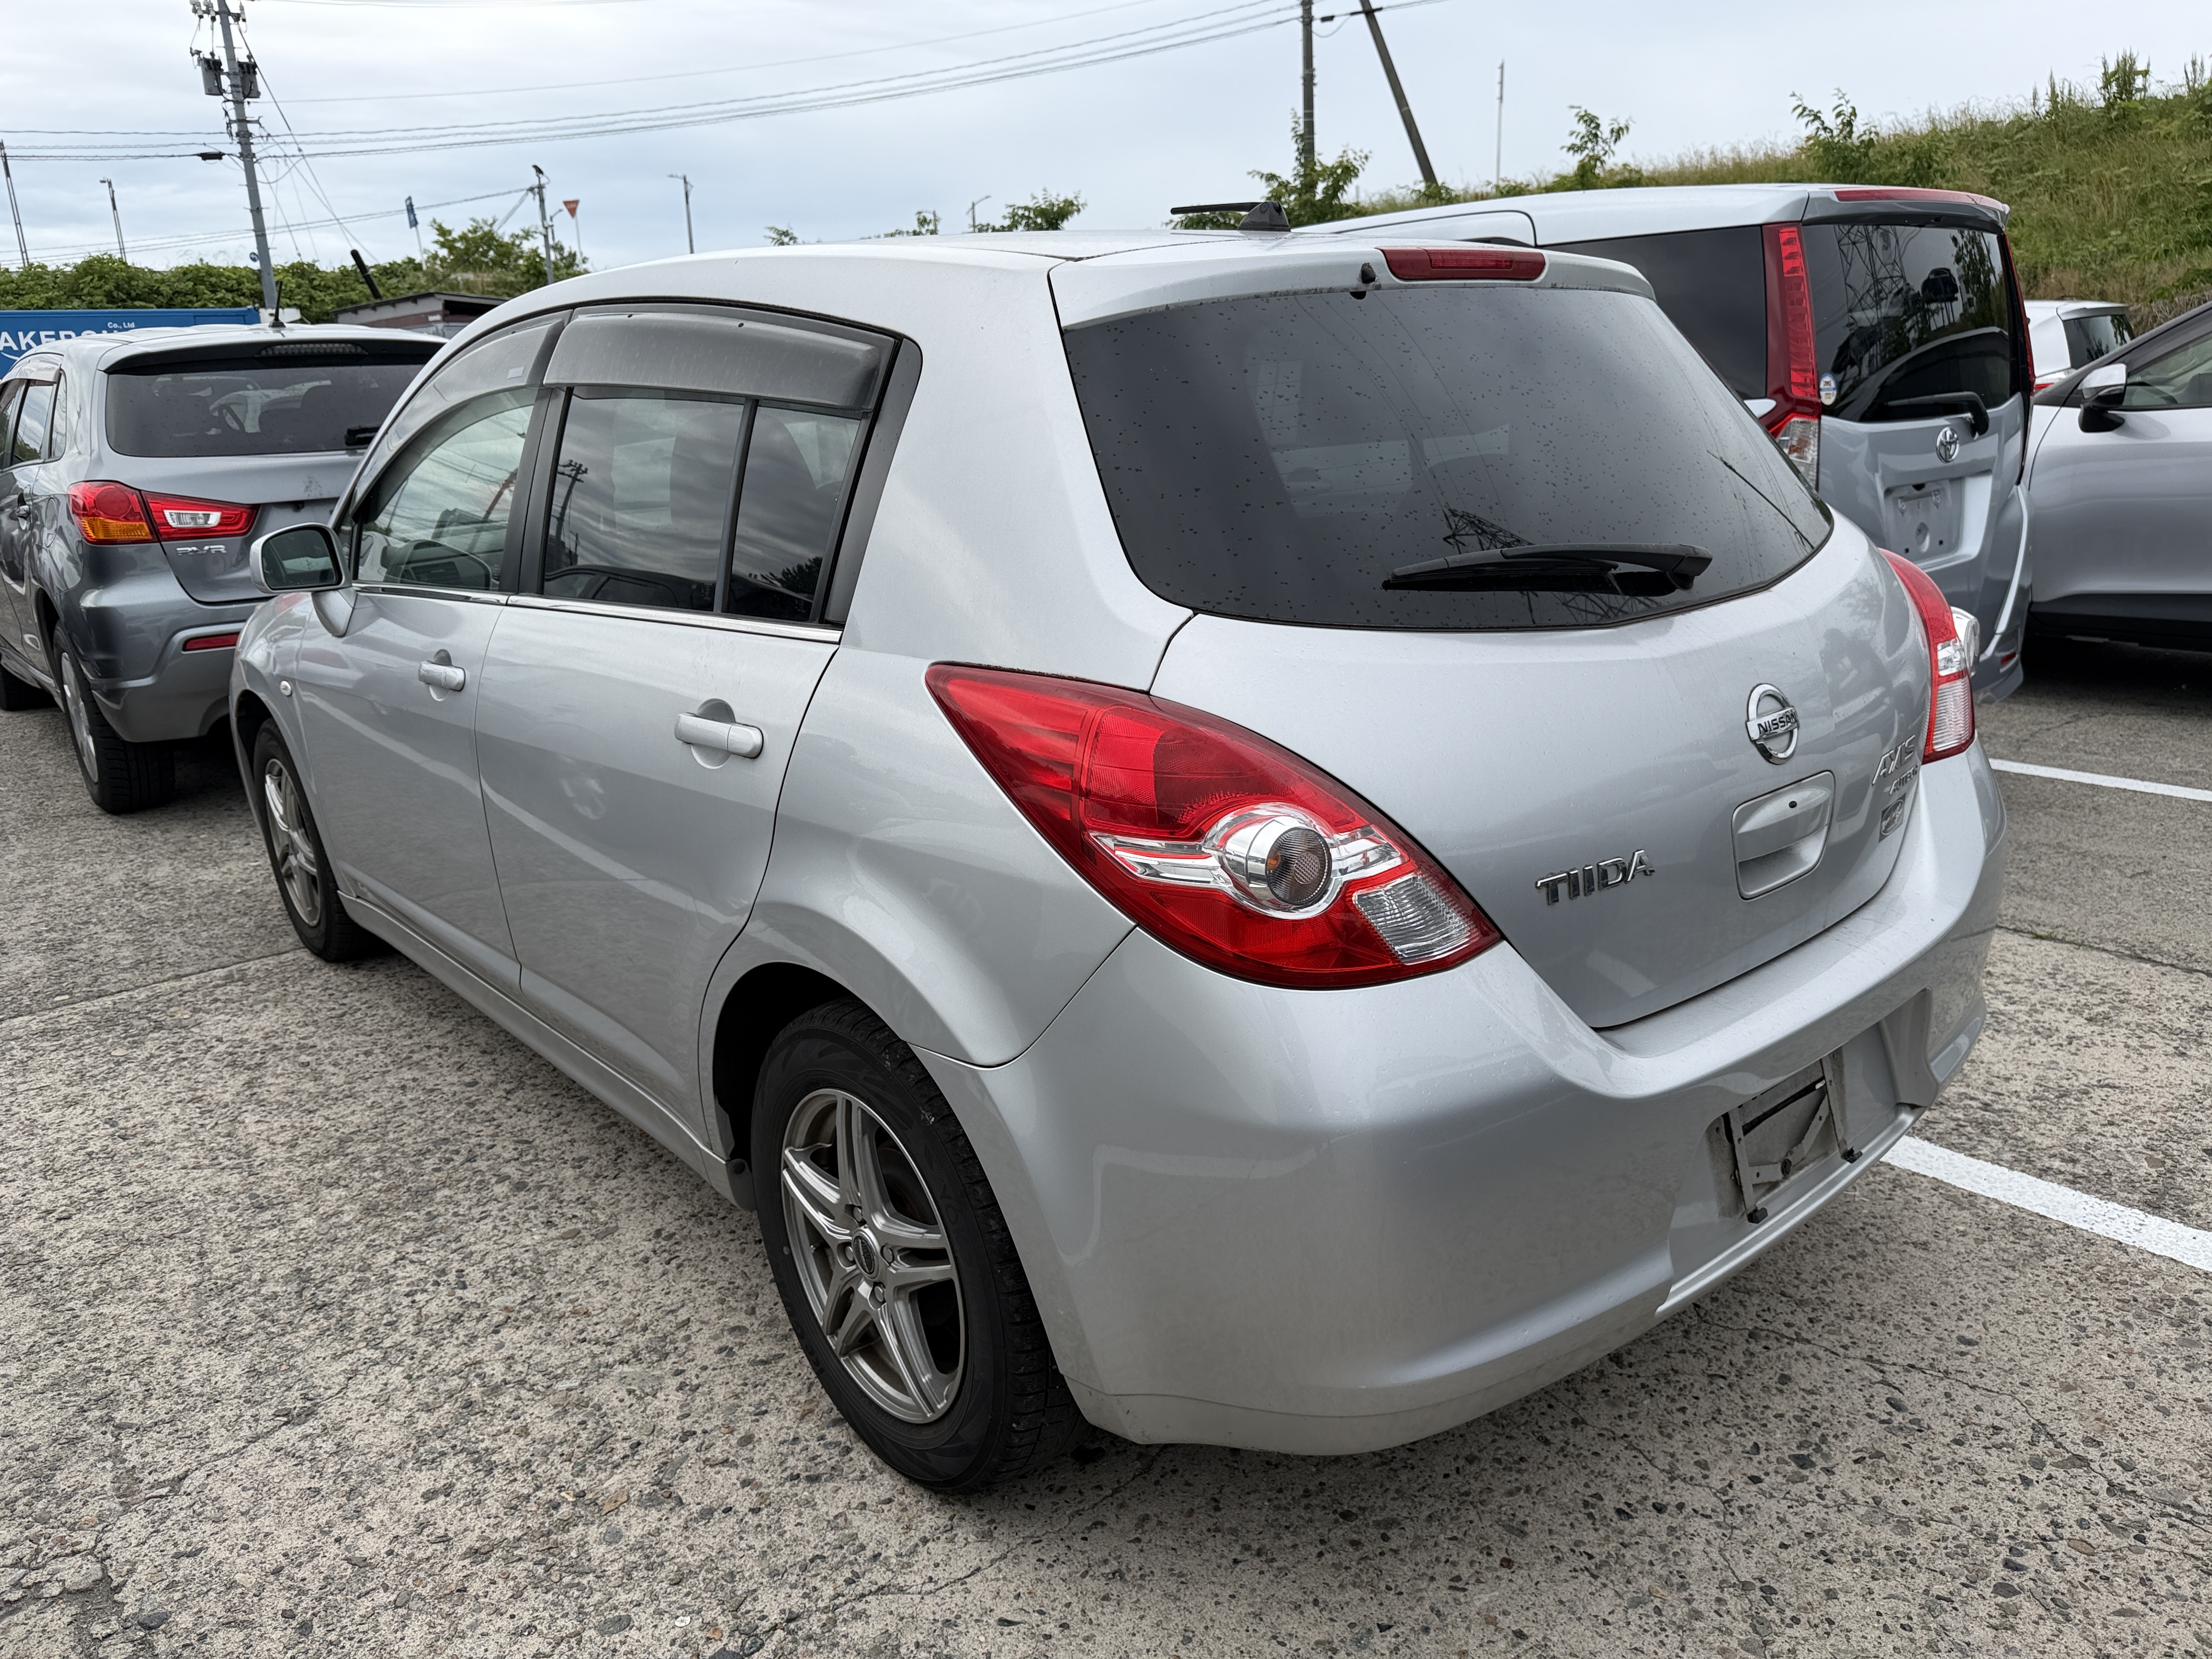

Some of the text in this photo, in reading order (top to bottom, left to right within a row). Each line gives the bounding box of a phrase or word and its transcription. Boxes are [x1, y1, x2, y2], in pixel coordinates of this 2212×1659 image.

[176, 545, 227, 557] RVR
[1757, 710, 1797, 734] NISSAN
[1535, 849, 1655, 905] TIIDA
